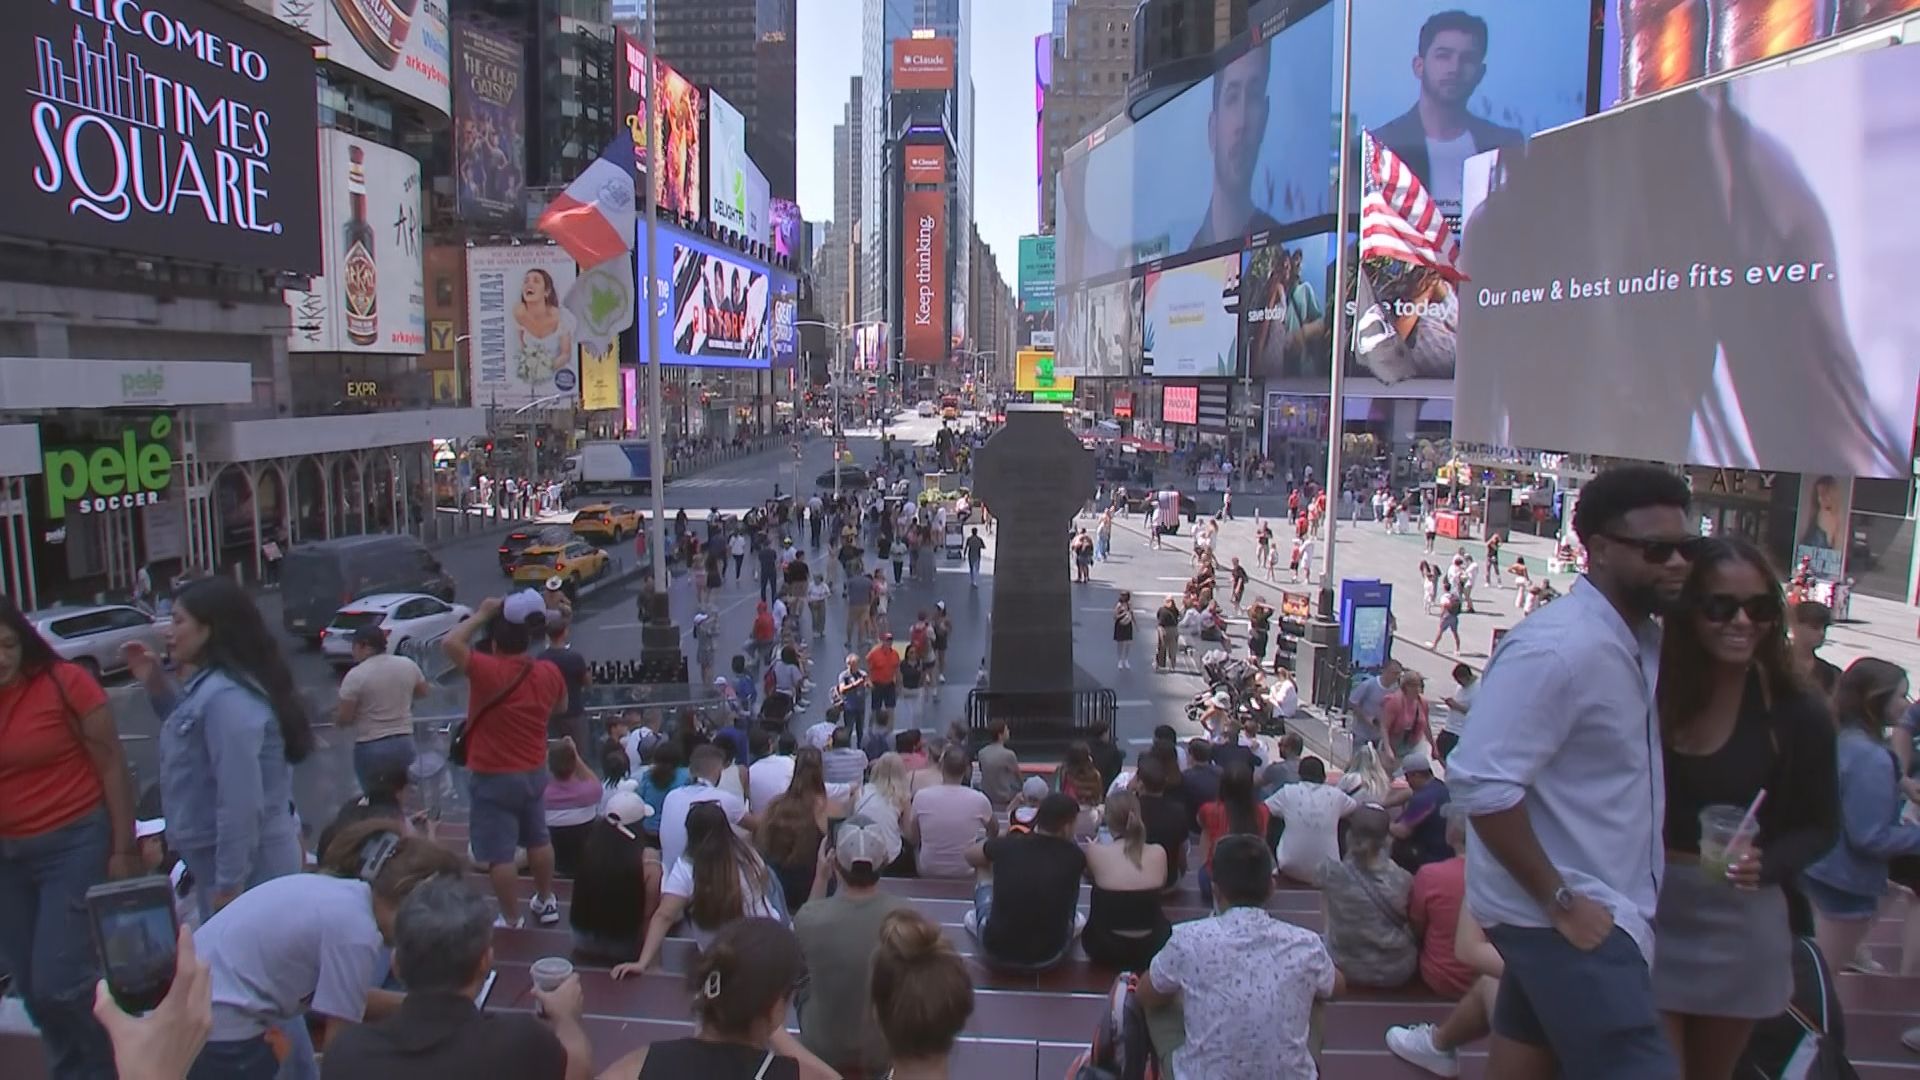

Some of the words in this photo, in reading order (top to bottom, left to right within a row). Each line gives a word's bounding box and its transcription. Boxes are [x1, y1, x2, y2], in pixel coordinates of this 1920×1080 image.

[227, 42, 269, 82] TO
[913, 54, 945, 65] Claude
[471, 76, 513, 105] GATSBY
[145, 73, 270, 158] TIMES
[916, 215, 935, 283] thinking
[1479, 287, 1507, 307] Our
[1511, 287, 1545, 304] new
[1550, 280, 1563, 300] &
[1570, 277, 1611, 299] best
[1618, 268, 1680, 295] undie
[1689, 263, 1733, 288] fits
[1745, 261, 1835, 284] ever.
[915, 285, 935, 325] Keep
[1248, 309, 1266, 322] save
[1265, 305, 1287, 322] today
[1395, 299, 1451, 320] today
[480, 316, 506, 382] MAMMA
[1228, 416, 1256, 428] SEPHRA
[45, 415, 172, 519] pelé
[79, 491, 159, 513] SOCCER
